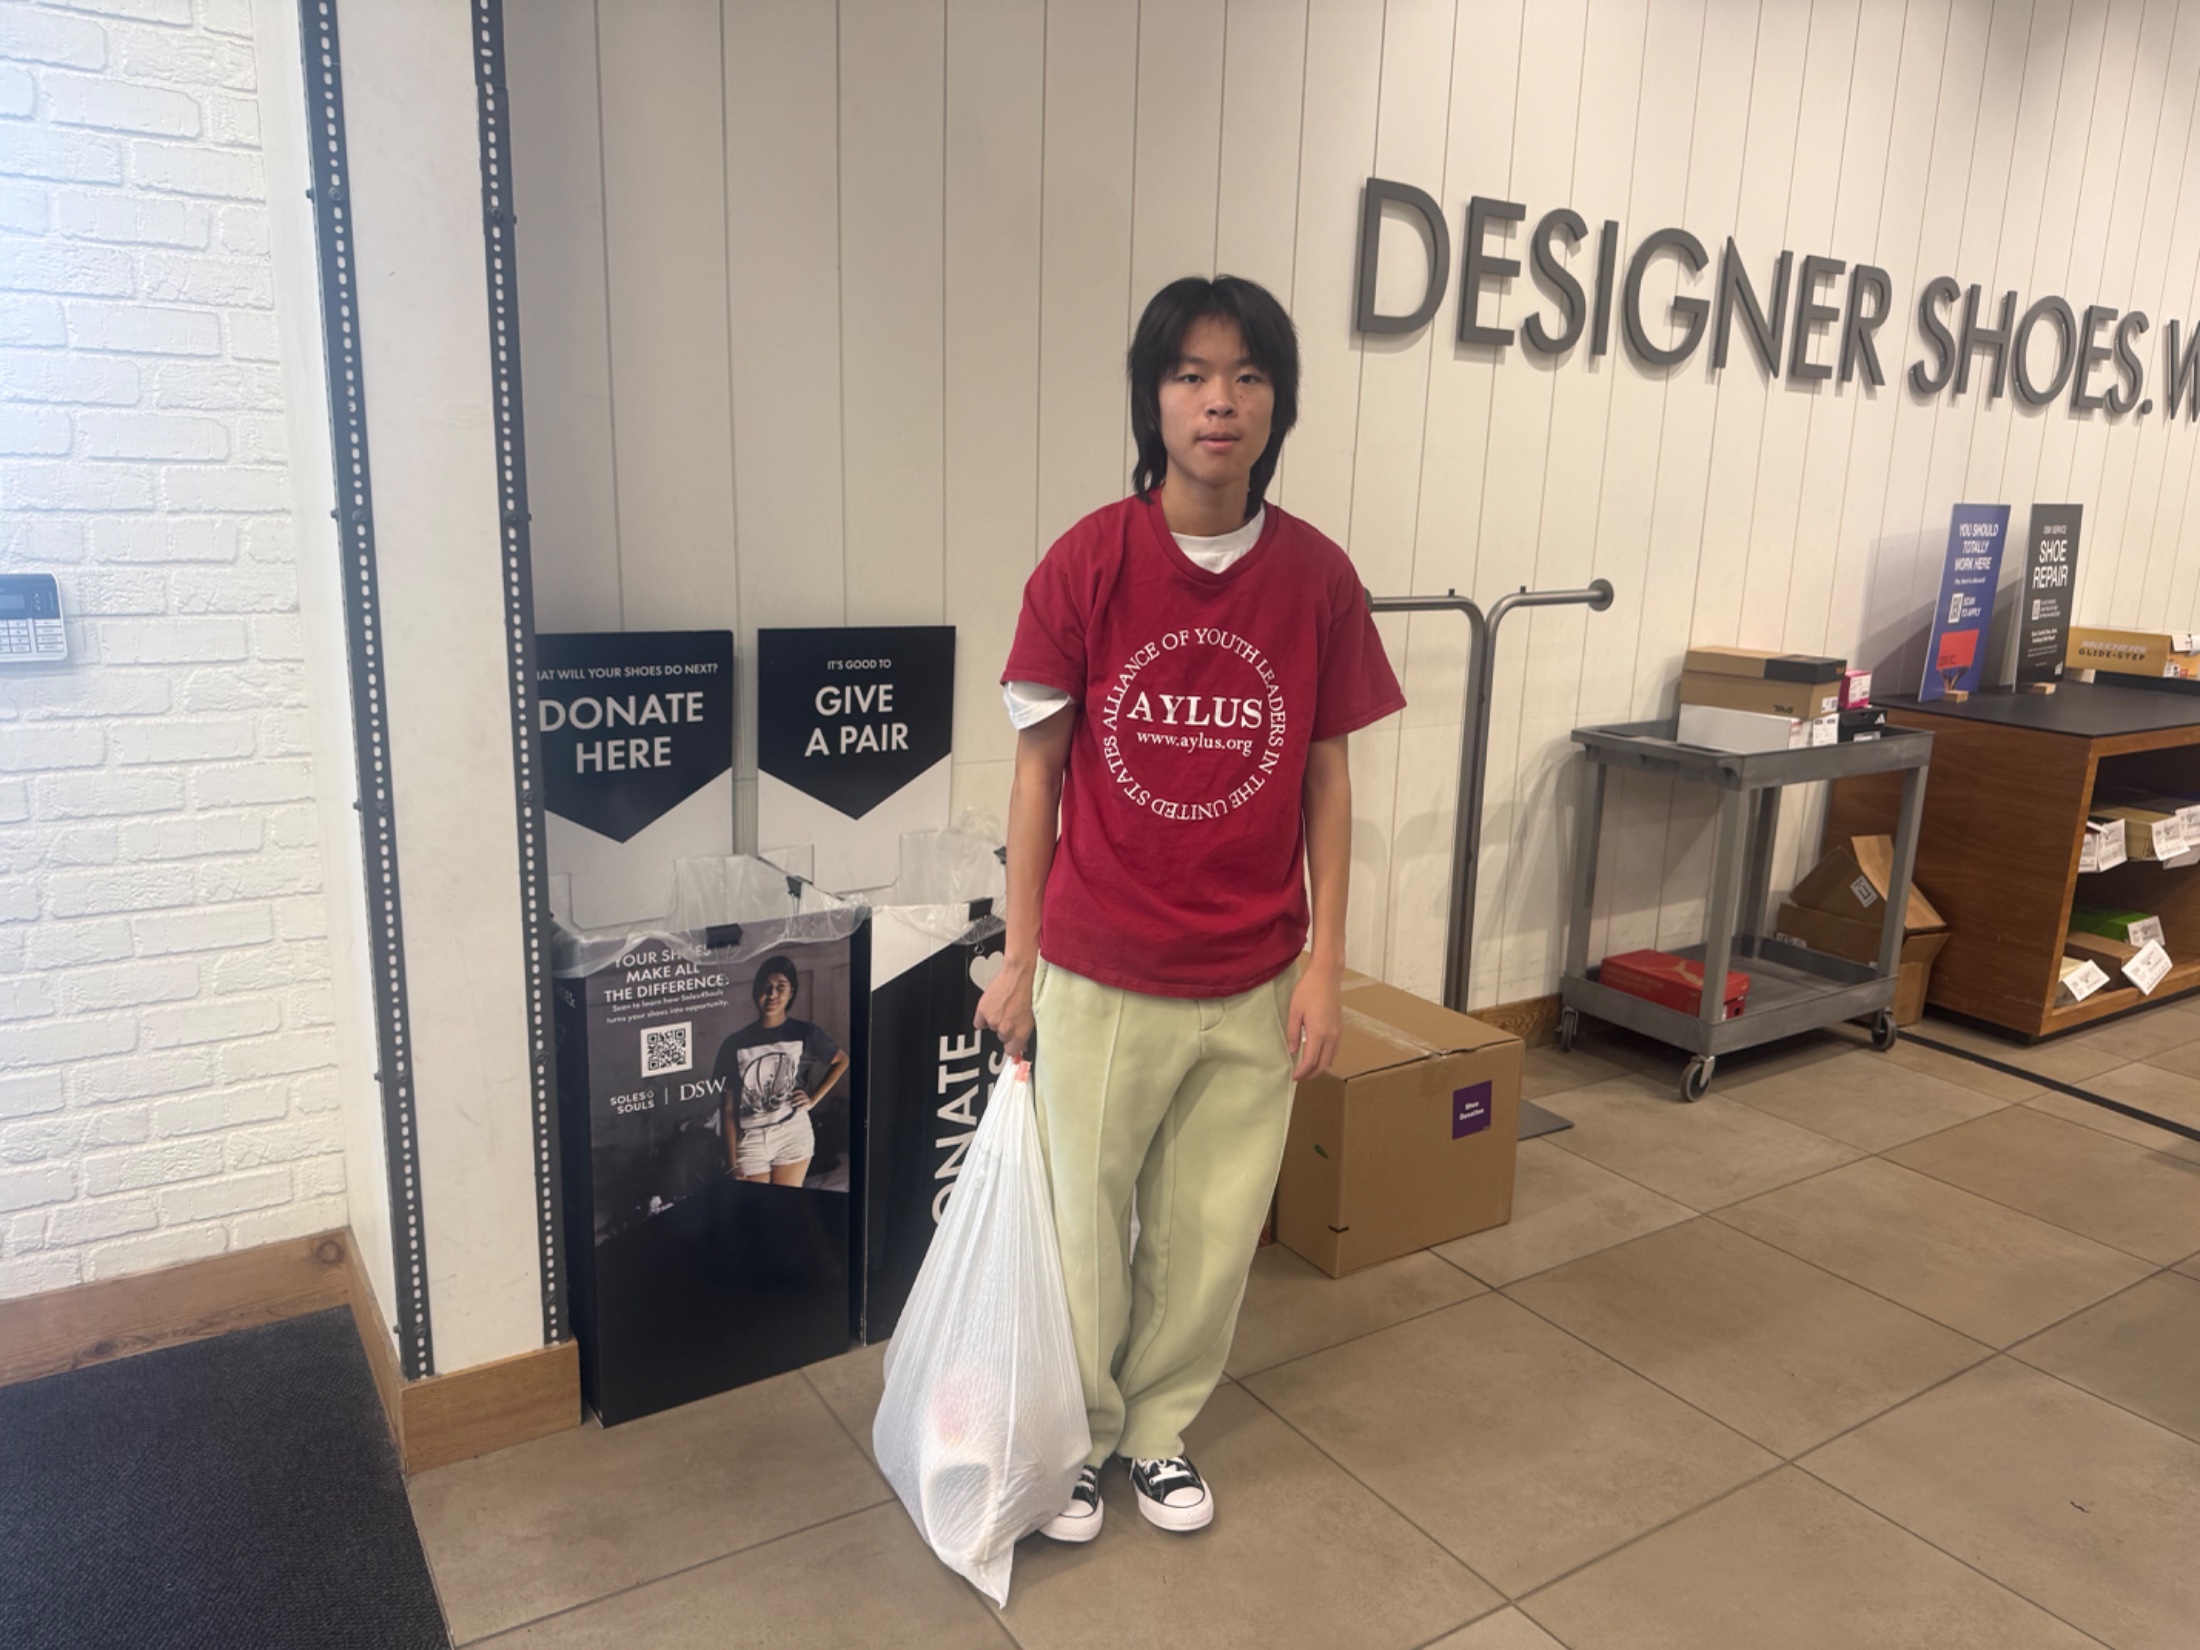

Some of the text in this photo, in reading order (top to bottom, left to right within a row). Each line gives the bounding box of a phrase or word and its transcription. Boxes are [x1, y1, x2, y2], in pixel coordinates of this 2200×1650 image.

[1355, 176, 1894, 388] DESIGNER
[1909, 276, 2153, 415] SHOES.
[1959, 523, 1999, 537] YOU SHOULD
[1963, 540, 1989, 554] TOTALLY
[2039, 539, 2068, 563] SHOE
[1954, 556, 1993, 571] WORK HERE
[2032, 565, 2069, 589] REPAIR
[536, 663, 718, 681] AT WILL YOUR SHOES DO NEXT?
[827, 658, 892, 670] IT'S GOOD TO
[538, 691, 704, 732] DONATE
[815, 683, 894, 717] GIVE
[1126, 690, 1264, 729] AYLUS
[1102, 627, 1287, 821] ALLIANCE OF YOUTH LEADERS IN THE UNITED STATES
[804, 722, 909, 757] A PAIR
[1136, 731, 1253, 757] www.aylus.org
[576, 736, 672, 774] HERE
[626, 961, 700, 983] MAKE ALL
[603, 987, 633, 1003] THE
[612, 1003, 631, 1013] Scan
[632, 1002, 640, 1010] to
[642, 999, 662, 1008] learn
[663, 996, 680, 1004] how
[606, 1015, 626, 1024] turns
[628, 1013, 646, 1023] your
[647, 1009, 668, 1018] shoes
[669, 1006, 684, 1015] into
[679, 1076, 727, 1101] DSW
[617, 1100, 655, 1115] SOULS
